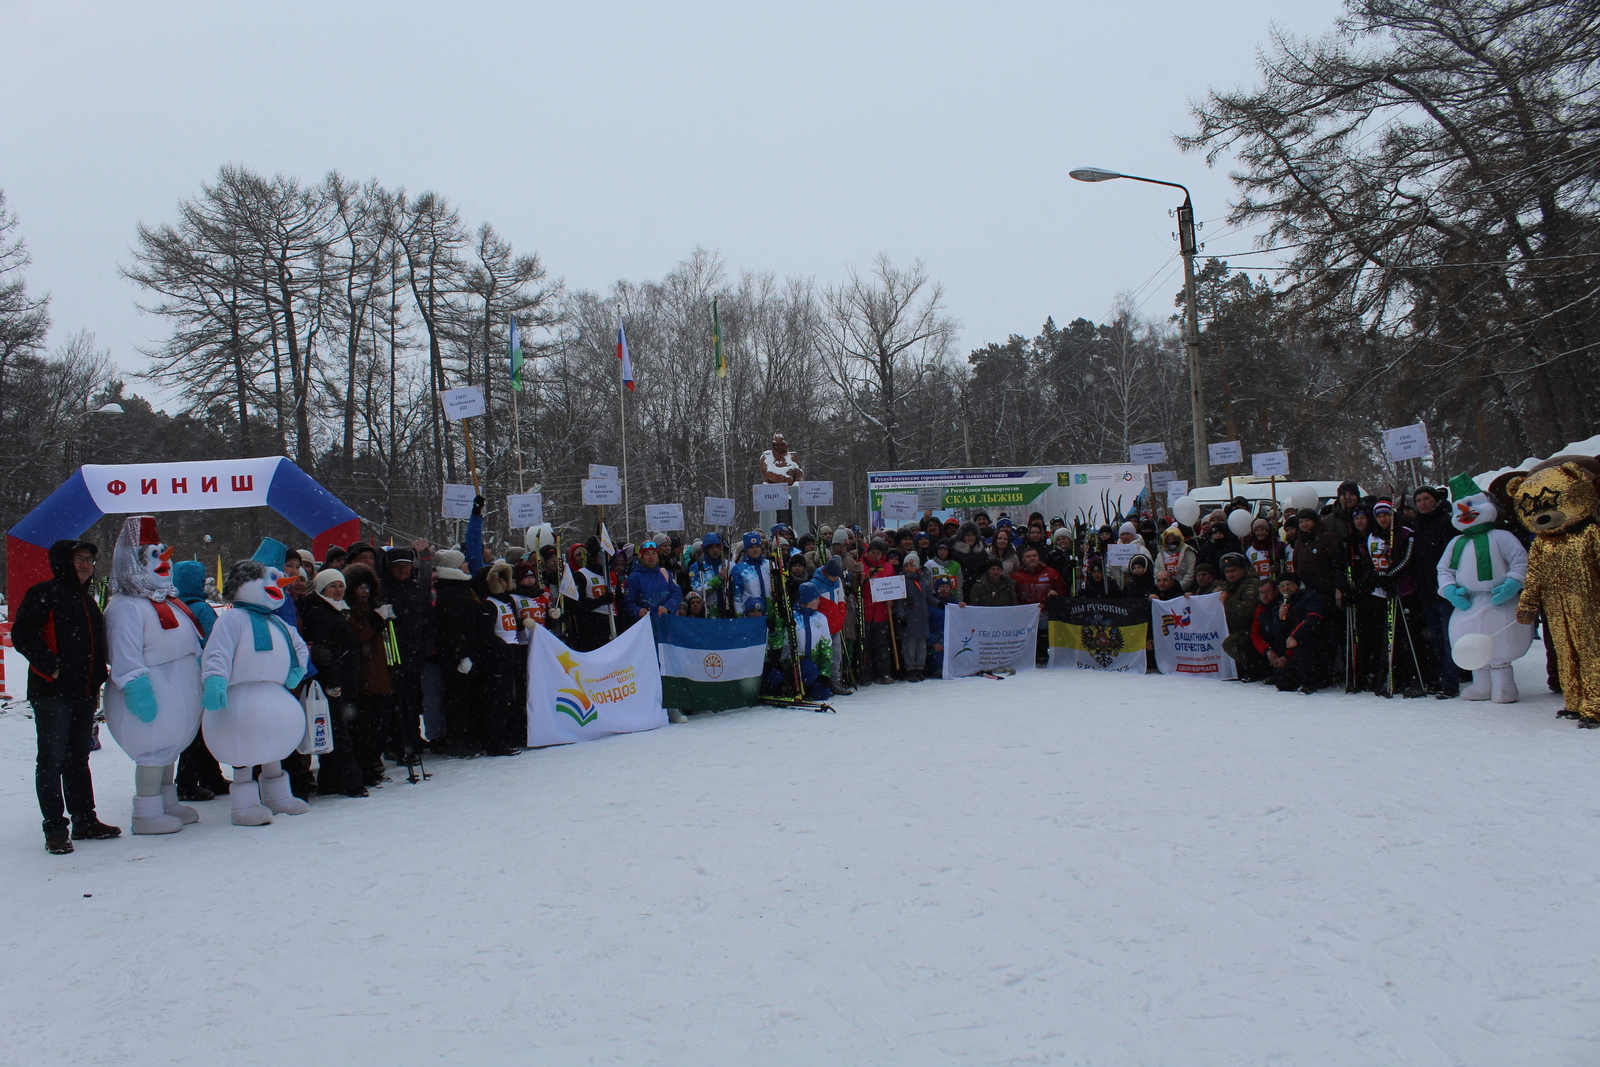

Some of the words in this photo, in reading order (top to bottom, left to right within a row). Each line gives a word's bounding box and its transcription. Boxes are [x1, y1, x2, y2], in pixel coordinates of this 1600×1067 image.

[107, 475, 253, 495] ФИНИШ
[927, 481, 971, 489] государственных
[950, 486, 980, 494] Республики
[945, 494, 977, 504] СКАЯ
[979, 493, 1023, 503] ЛЫЖНЯ
[1086, 603, 1128, 616] РУССКИЕ
[978, 630, 991, 638] ГБУ
[1013, 628, 1026, 637] ЦАС
[1174, 631, 1219, 642] ЗАЩИТНИКИ
[1174, 643, 1214, 652] ОТЕЧЕСТВА
[585, 665, 634, 683] ОБРАЗОВАТЕЛЬНЫЙ
[617, 672, 635, 684] ЦЕНТР
[588, 682, 637, 704] ЙОНДОЗ
